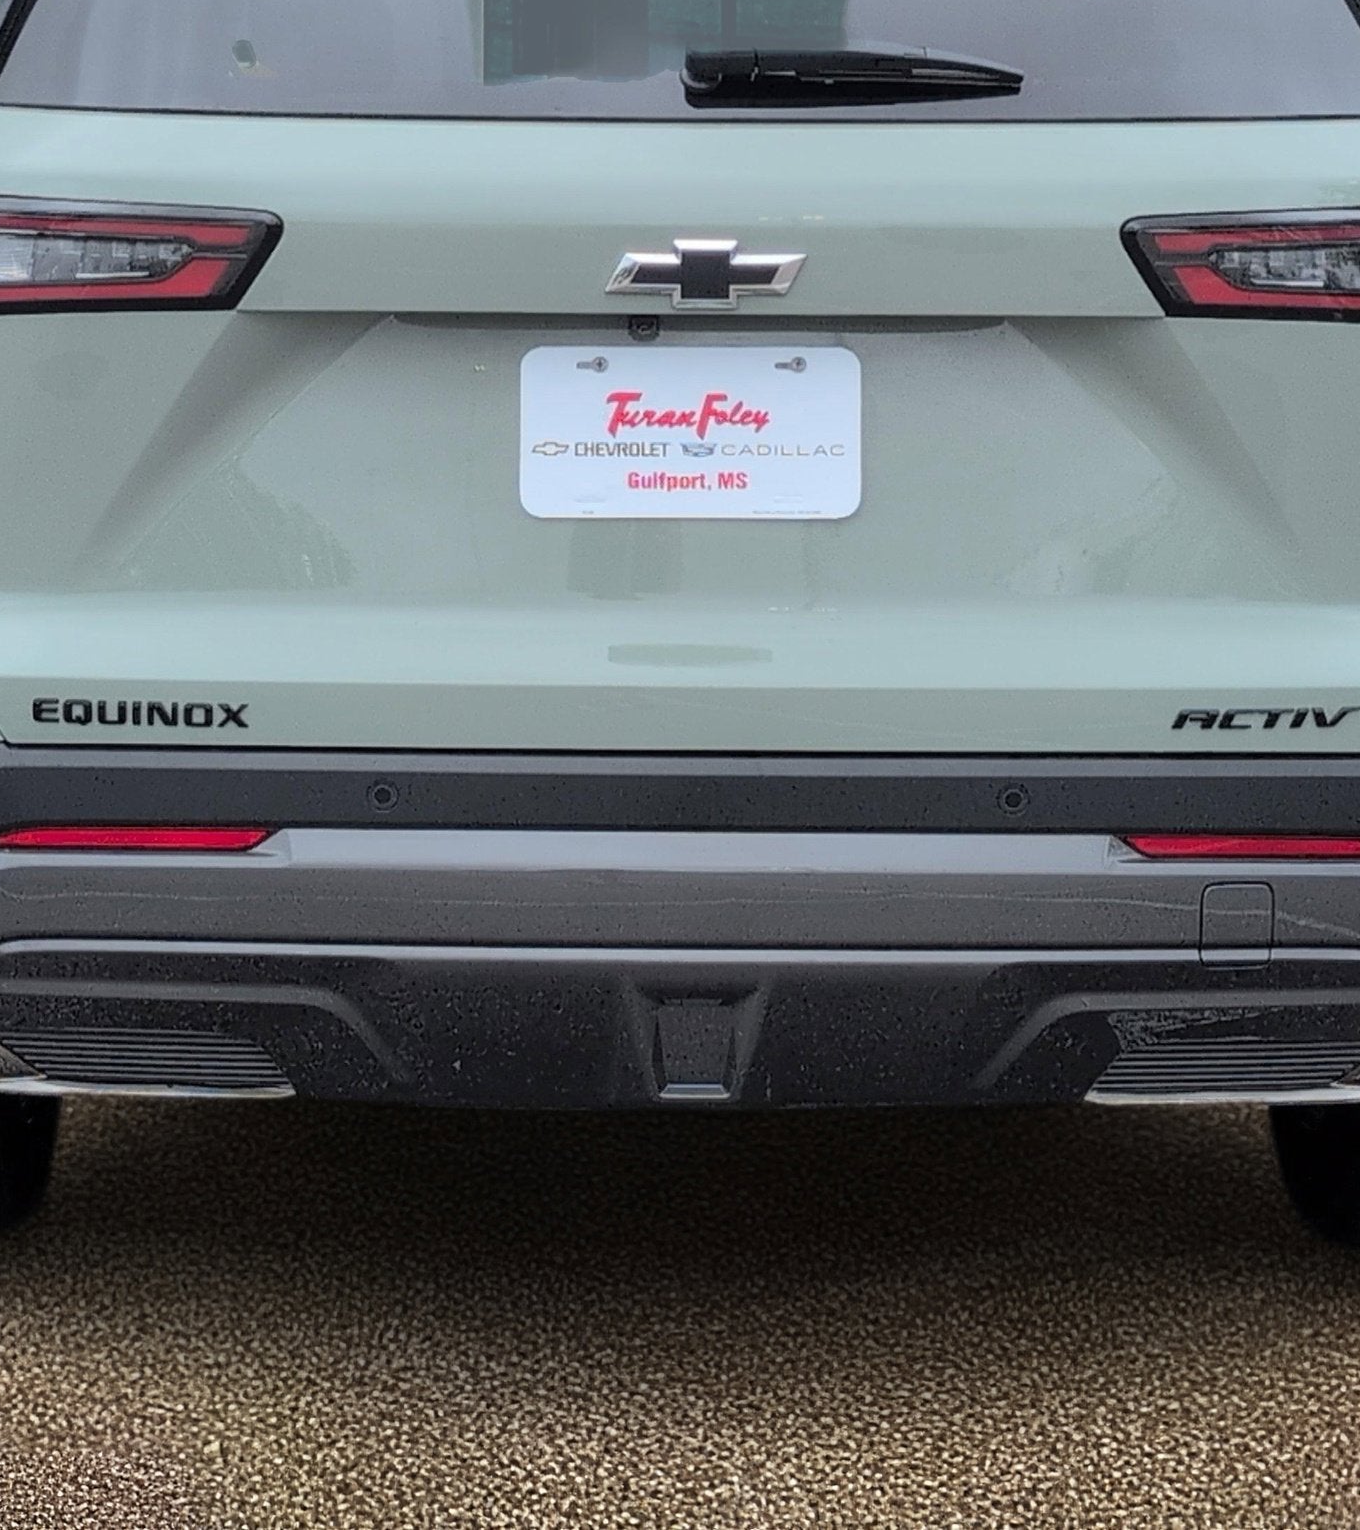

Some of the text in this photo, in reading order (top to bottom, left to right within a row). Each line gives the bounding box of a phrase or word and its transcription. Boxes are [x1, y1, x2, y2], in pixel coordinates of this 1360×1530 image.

[606, 391, 770, 440] Turan Foley
[574, 441, 846, 458] CHEVROLET CADILLAC
[627, 471, 749, 492] Gulfport, MS
[31, 697, 250, 729] EQUINOX
